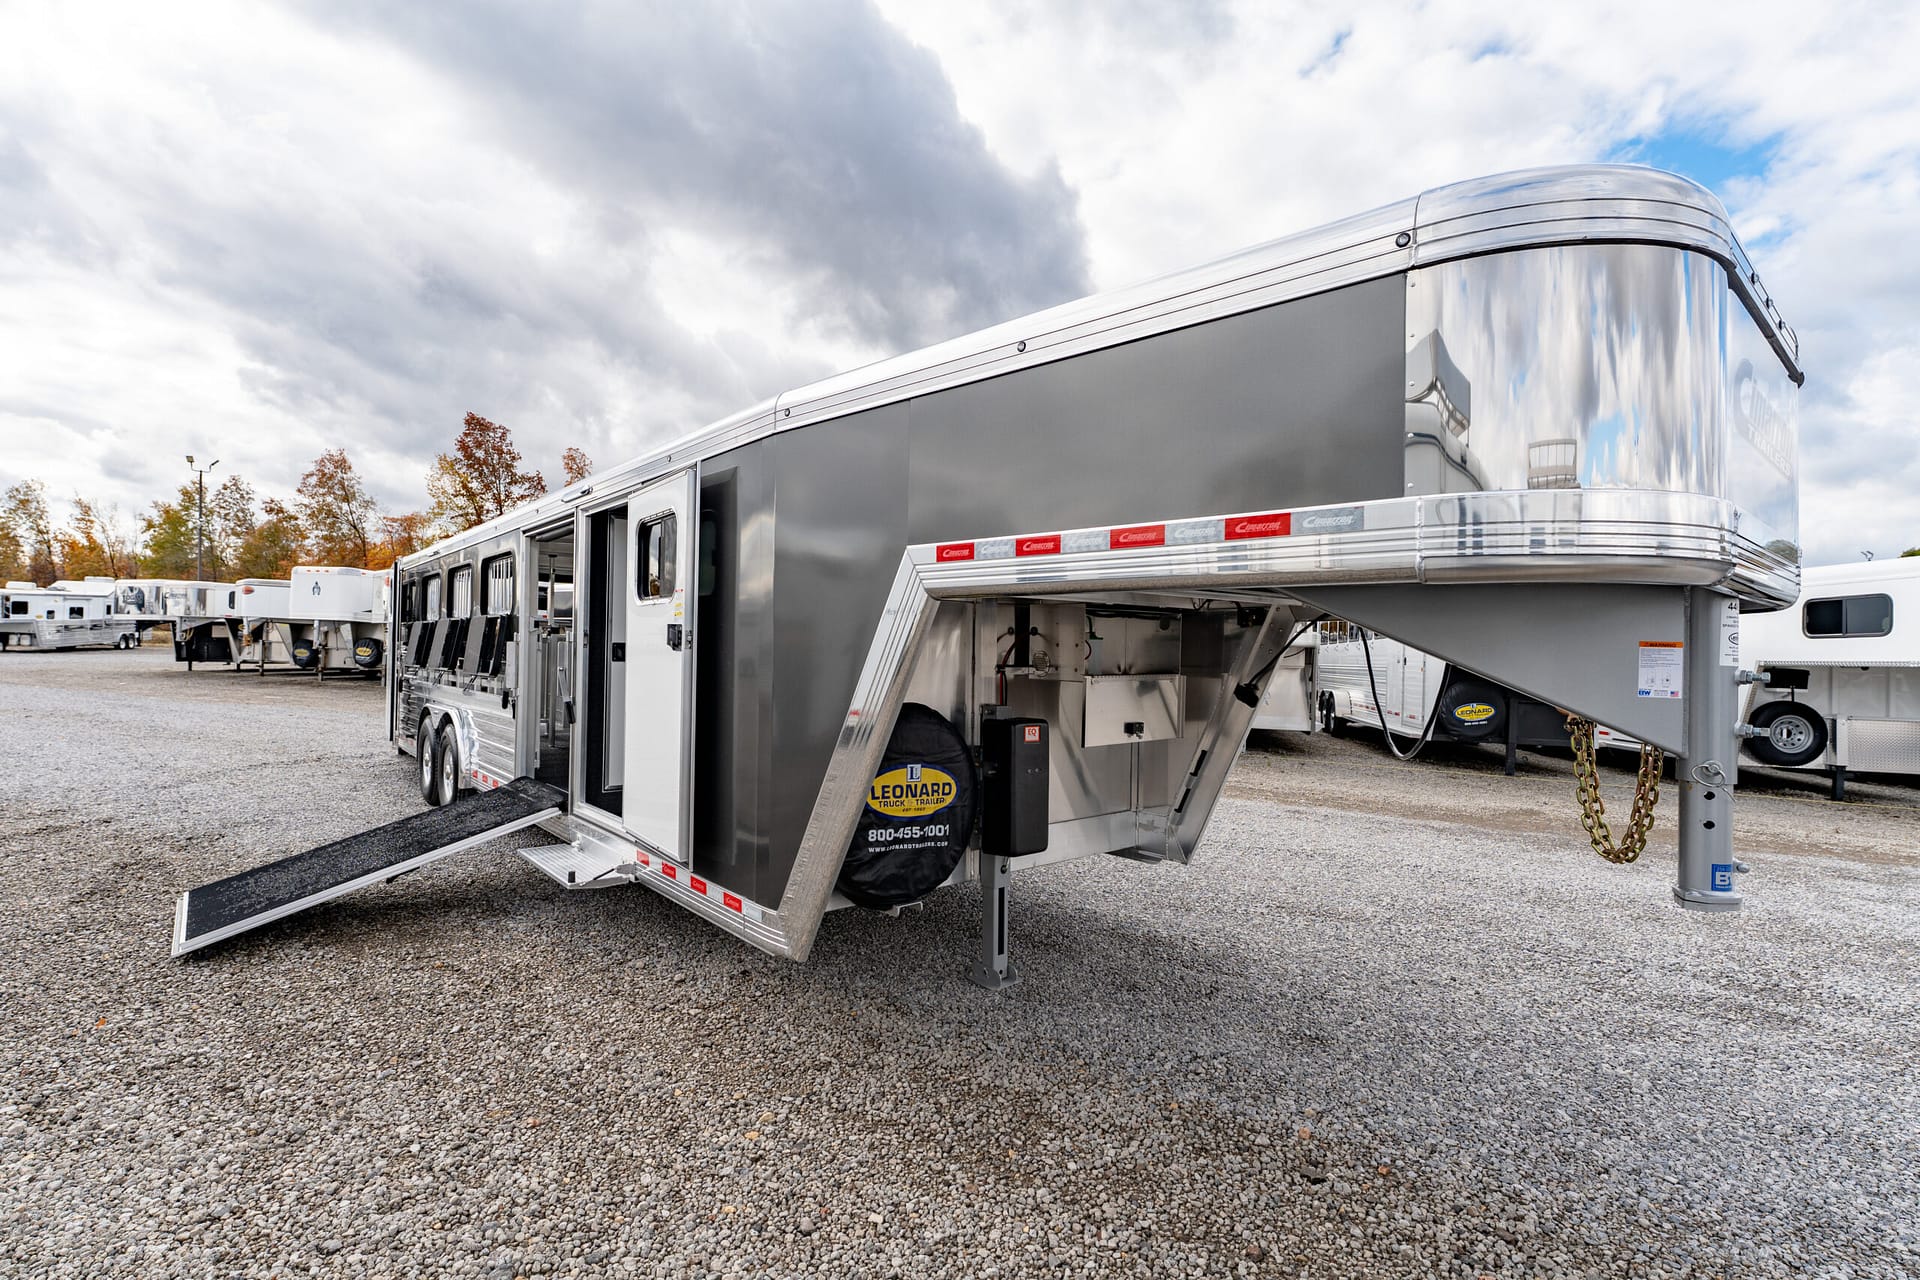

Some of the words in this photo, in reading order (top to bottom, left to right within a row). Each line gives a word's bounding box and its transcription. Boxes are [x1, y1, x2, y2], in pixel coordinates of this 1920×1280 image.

[1027, 728, 1037, 736] EQ
[870, 782, 952, 800] LEONARD
[879, 800, 905, 808] TRUCK
[916, 797, 945, 806] TRAILER
[868, 824, 950, 842] 800-455-1001
